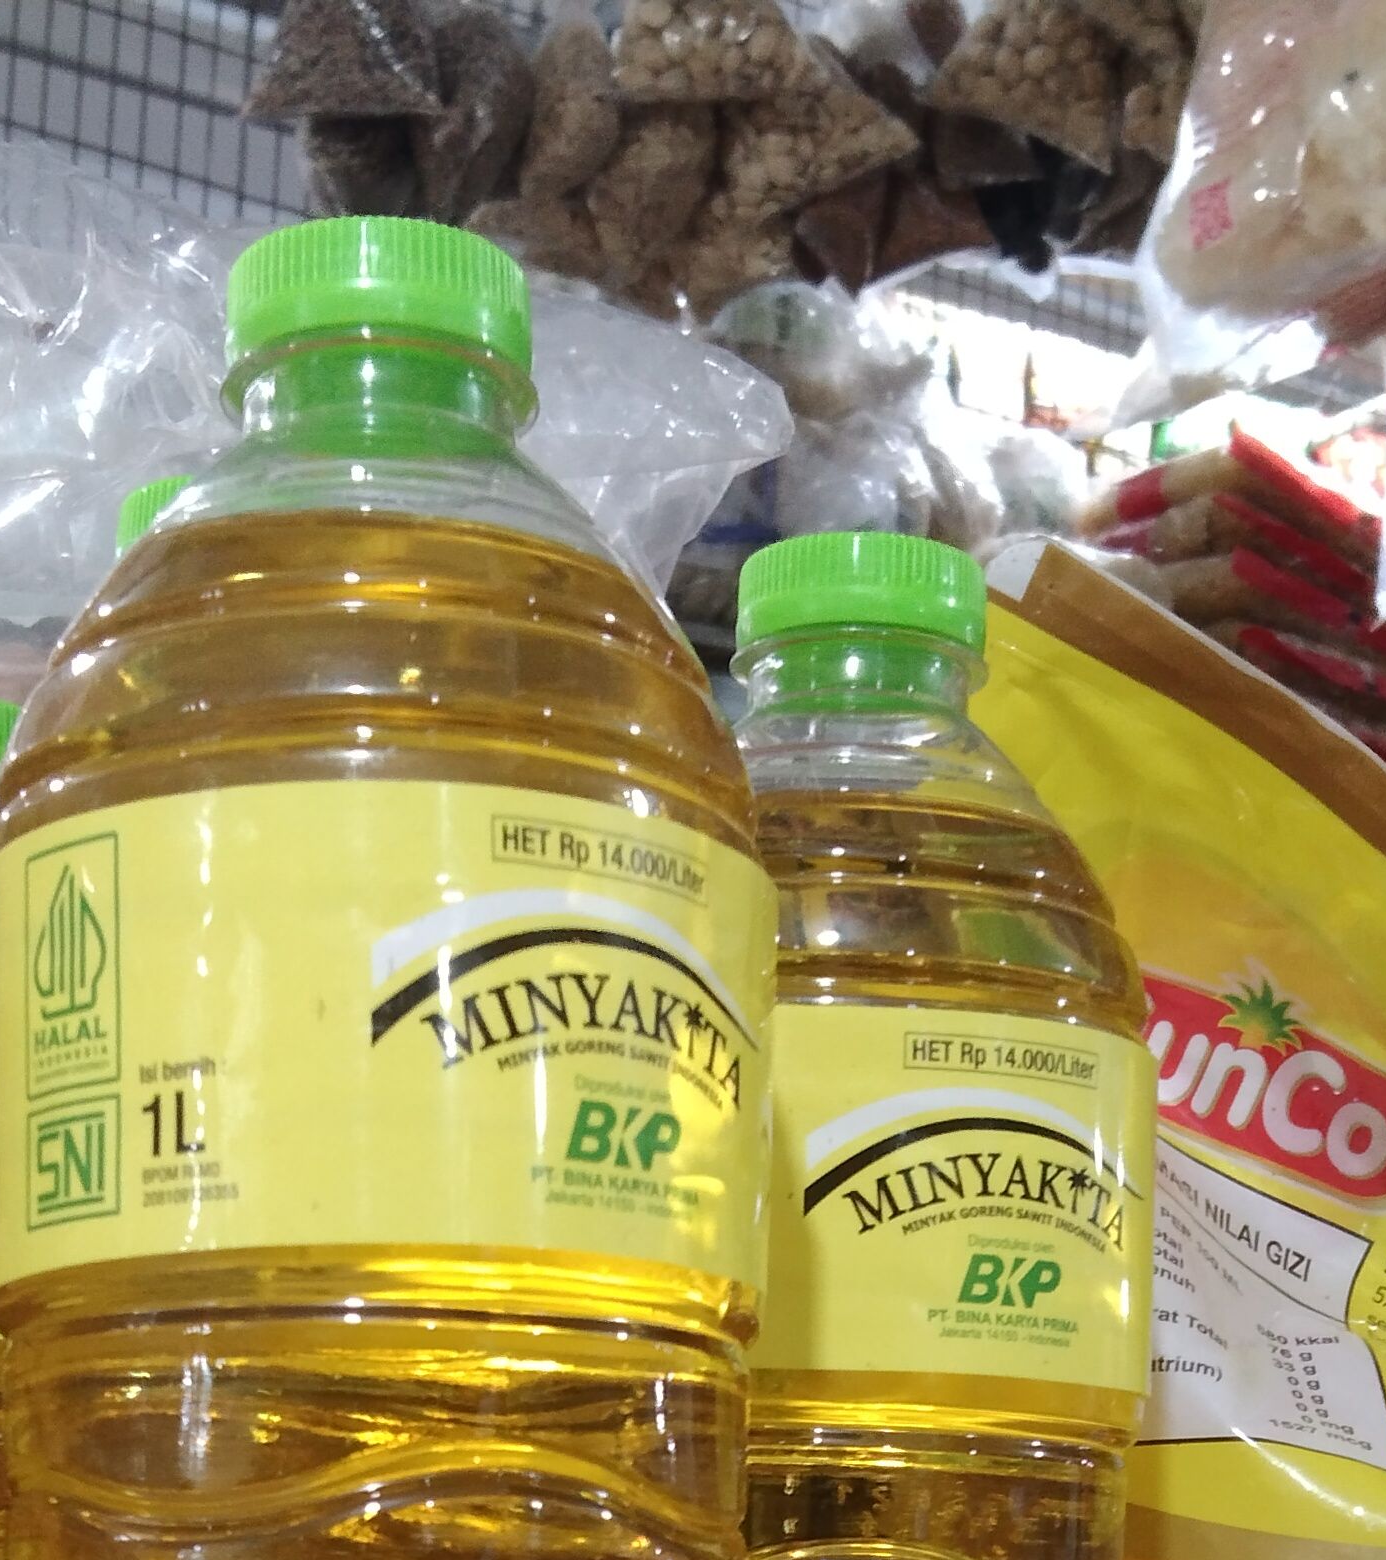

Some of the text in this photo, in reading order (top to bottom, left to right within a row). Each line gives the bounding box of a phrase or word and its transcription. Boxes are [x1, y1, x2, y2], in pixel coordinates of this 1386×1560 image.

[501, 824, 551, 856] HET
[559, 831, 590, 867] Rp
[34, 1014, 108, 1054] HALAL
[912, 1041, 1096, 1080] HET Rp 14.000/Liter
[36, 1119, 106, 1202] SNI
[565, 1098, 682, 1171] BKP
[843, 1153, 1125, 1252] MINYAKITA
[901, 1204, 1107, 1254] MINYAK GORENG SAWIT INDONESIA
[1204, 1197, 1261, 1253] NILAI
[1265, 1239, 1313, 1283] GIZI
[957, 1253, 1062, 1309] BKP
[955, 1310, 992, 1325] BINA
[995, 1314, 1040, 1330] KARYA
[1042, 1317, 1080, 1335] PRIMA
